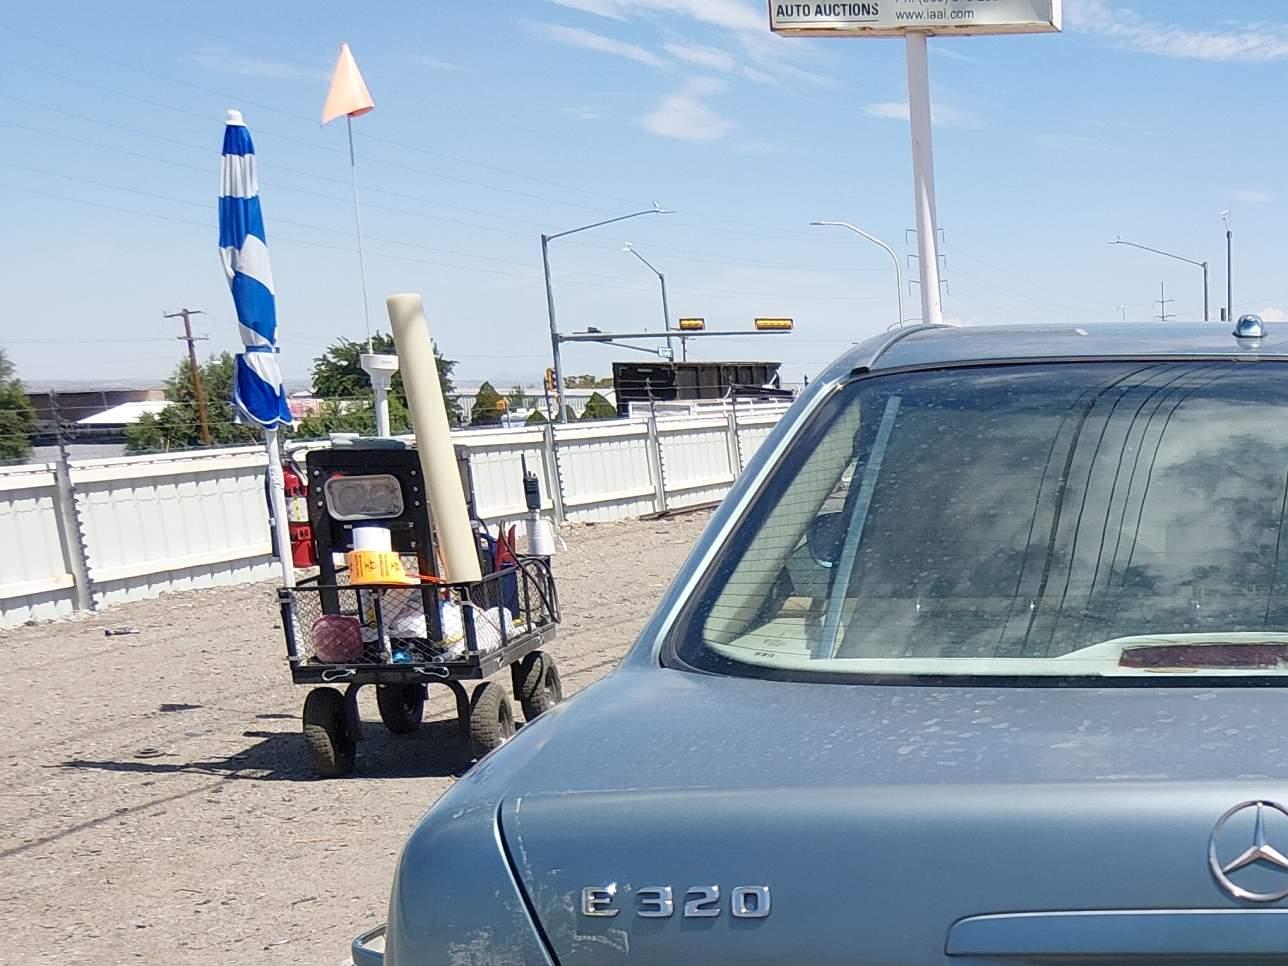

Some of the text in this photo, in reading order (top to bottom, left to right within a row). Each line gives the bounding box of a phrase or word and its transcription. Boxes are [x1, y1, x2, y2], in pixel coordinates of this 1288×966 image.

[776, 3, 879, 17] AUTO AUCTIONS
[895, 9, 975, 20] www.iaai.com
[581, 885, 771, 918] E 320
